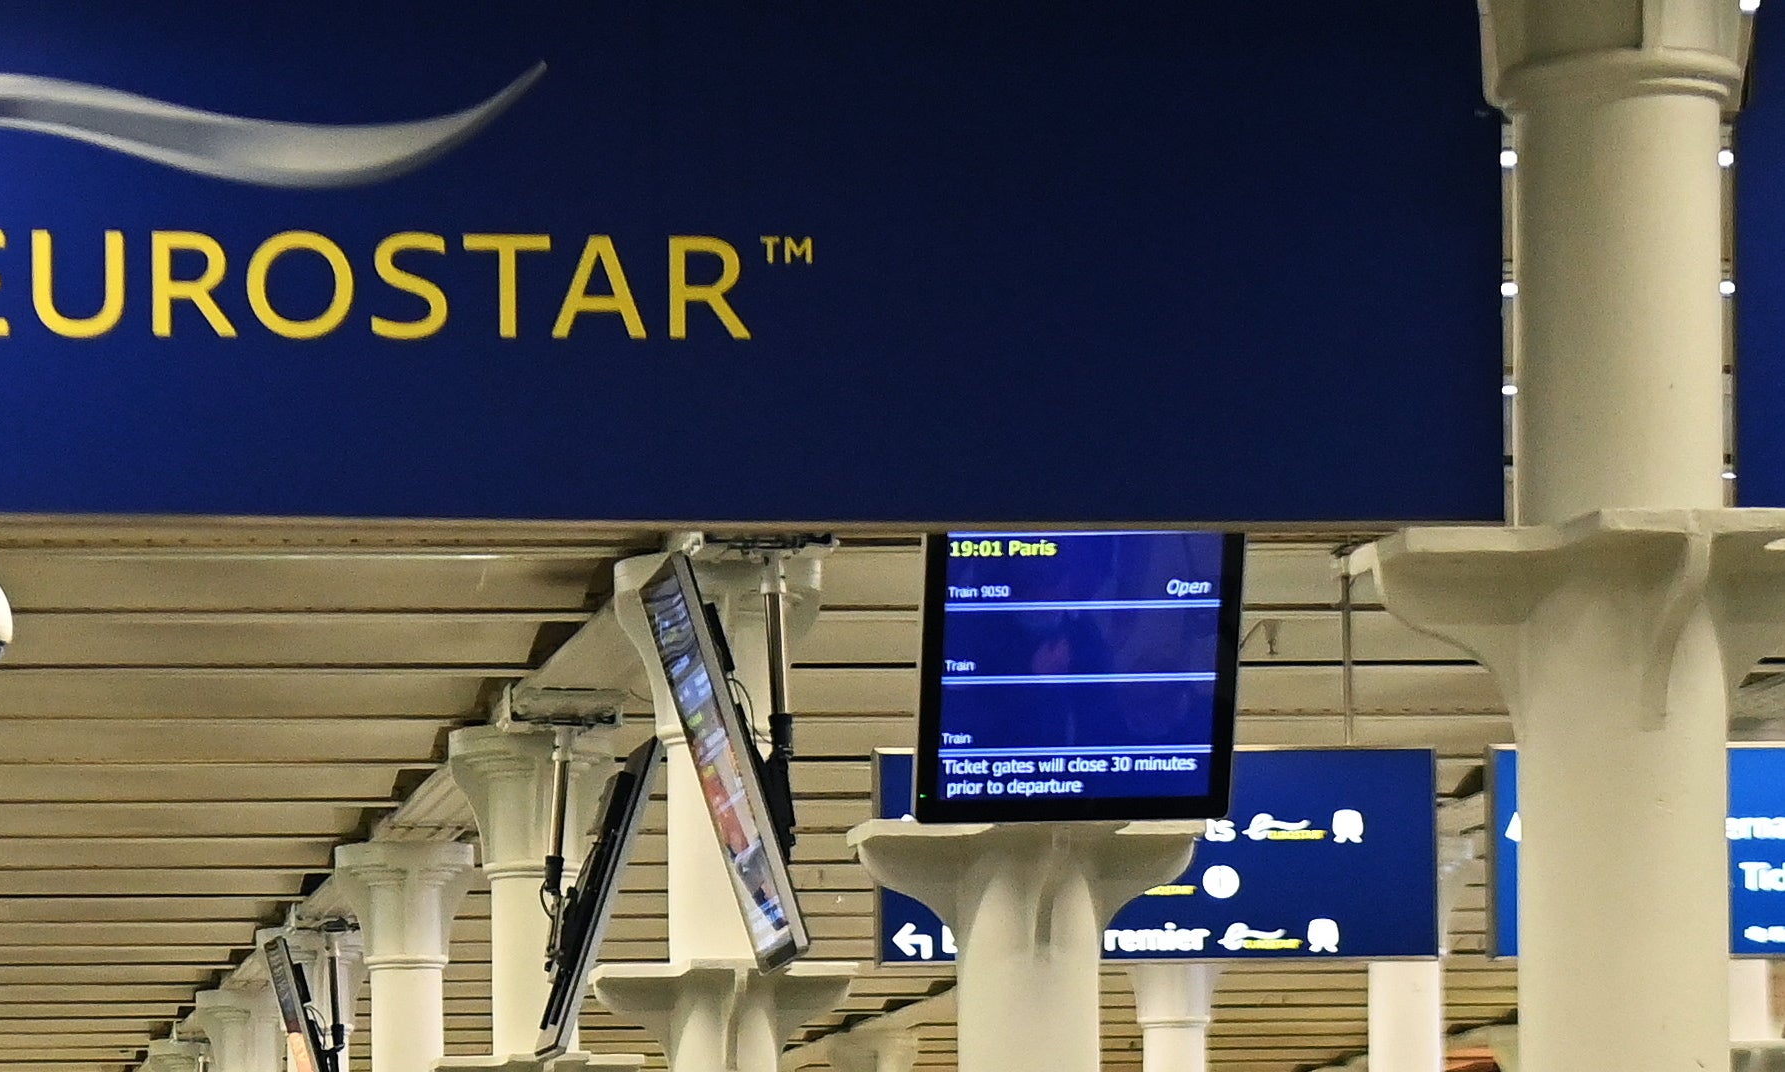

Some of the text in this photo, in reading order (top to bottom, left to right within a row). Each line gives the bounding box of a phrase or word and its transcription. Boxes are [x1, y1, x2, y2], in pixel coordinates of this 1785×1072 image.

[949, 539, 1057, 557] 19:01 Paris
[948, 585, 1010, 598] Train 9050
[1166, 578, 1211, 597] Open
[945, 659, 975, 672] Train
[941, 732, 972, 744] Train
[943, 755, 1197, 777] Ticket gates will close 30 minutes
[947, 779, 1083, 798] prior to departure
[1103, 921, 1212, 952] remier
